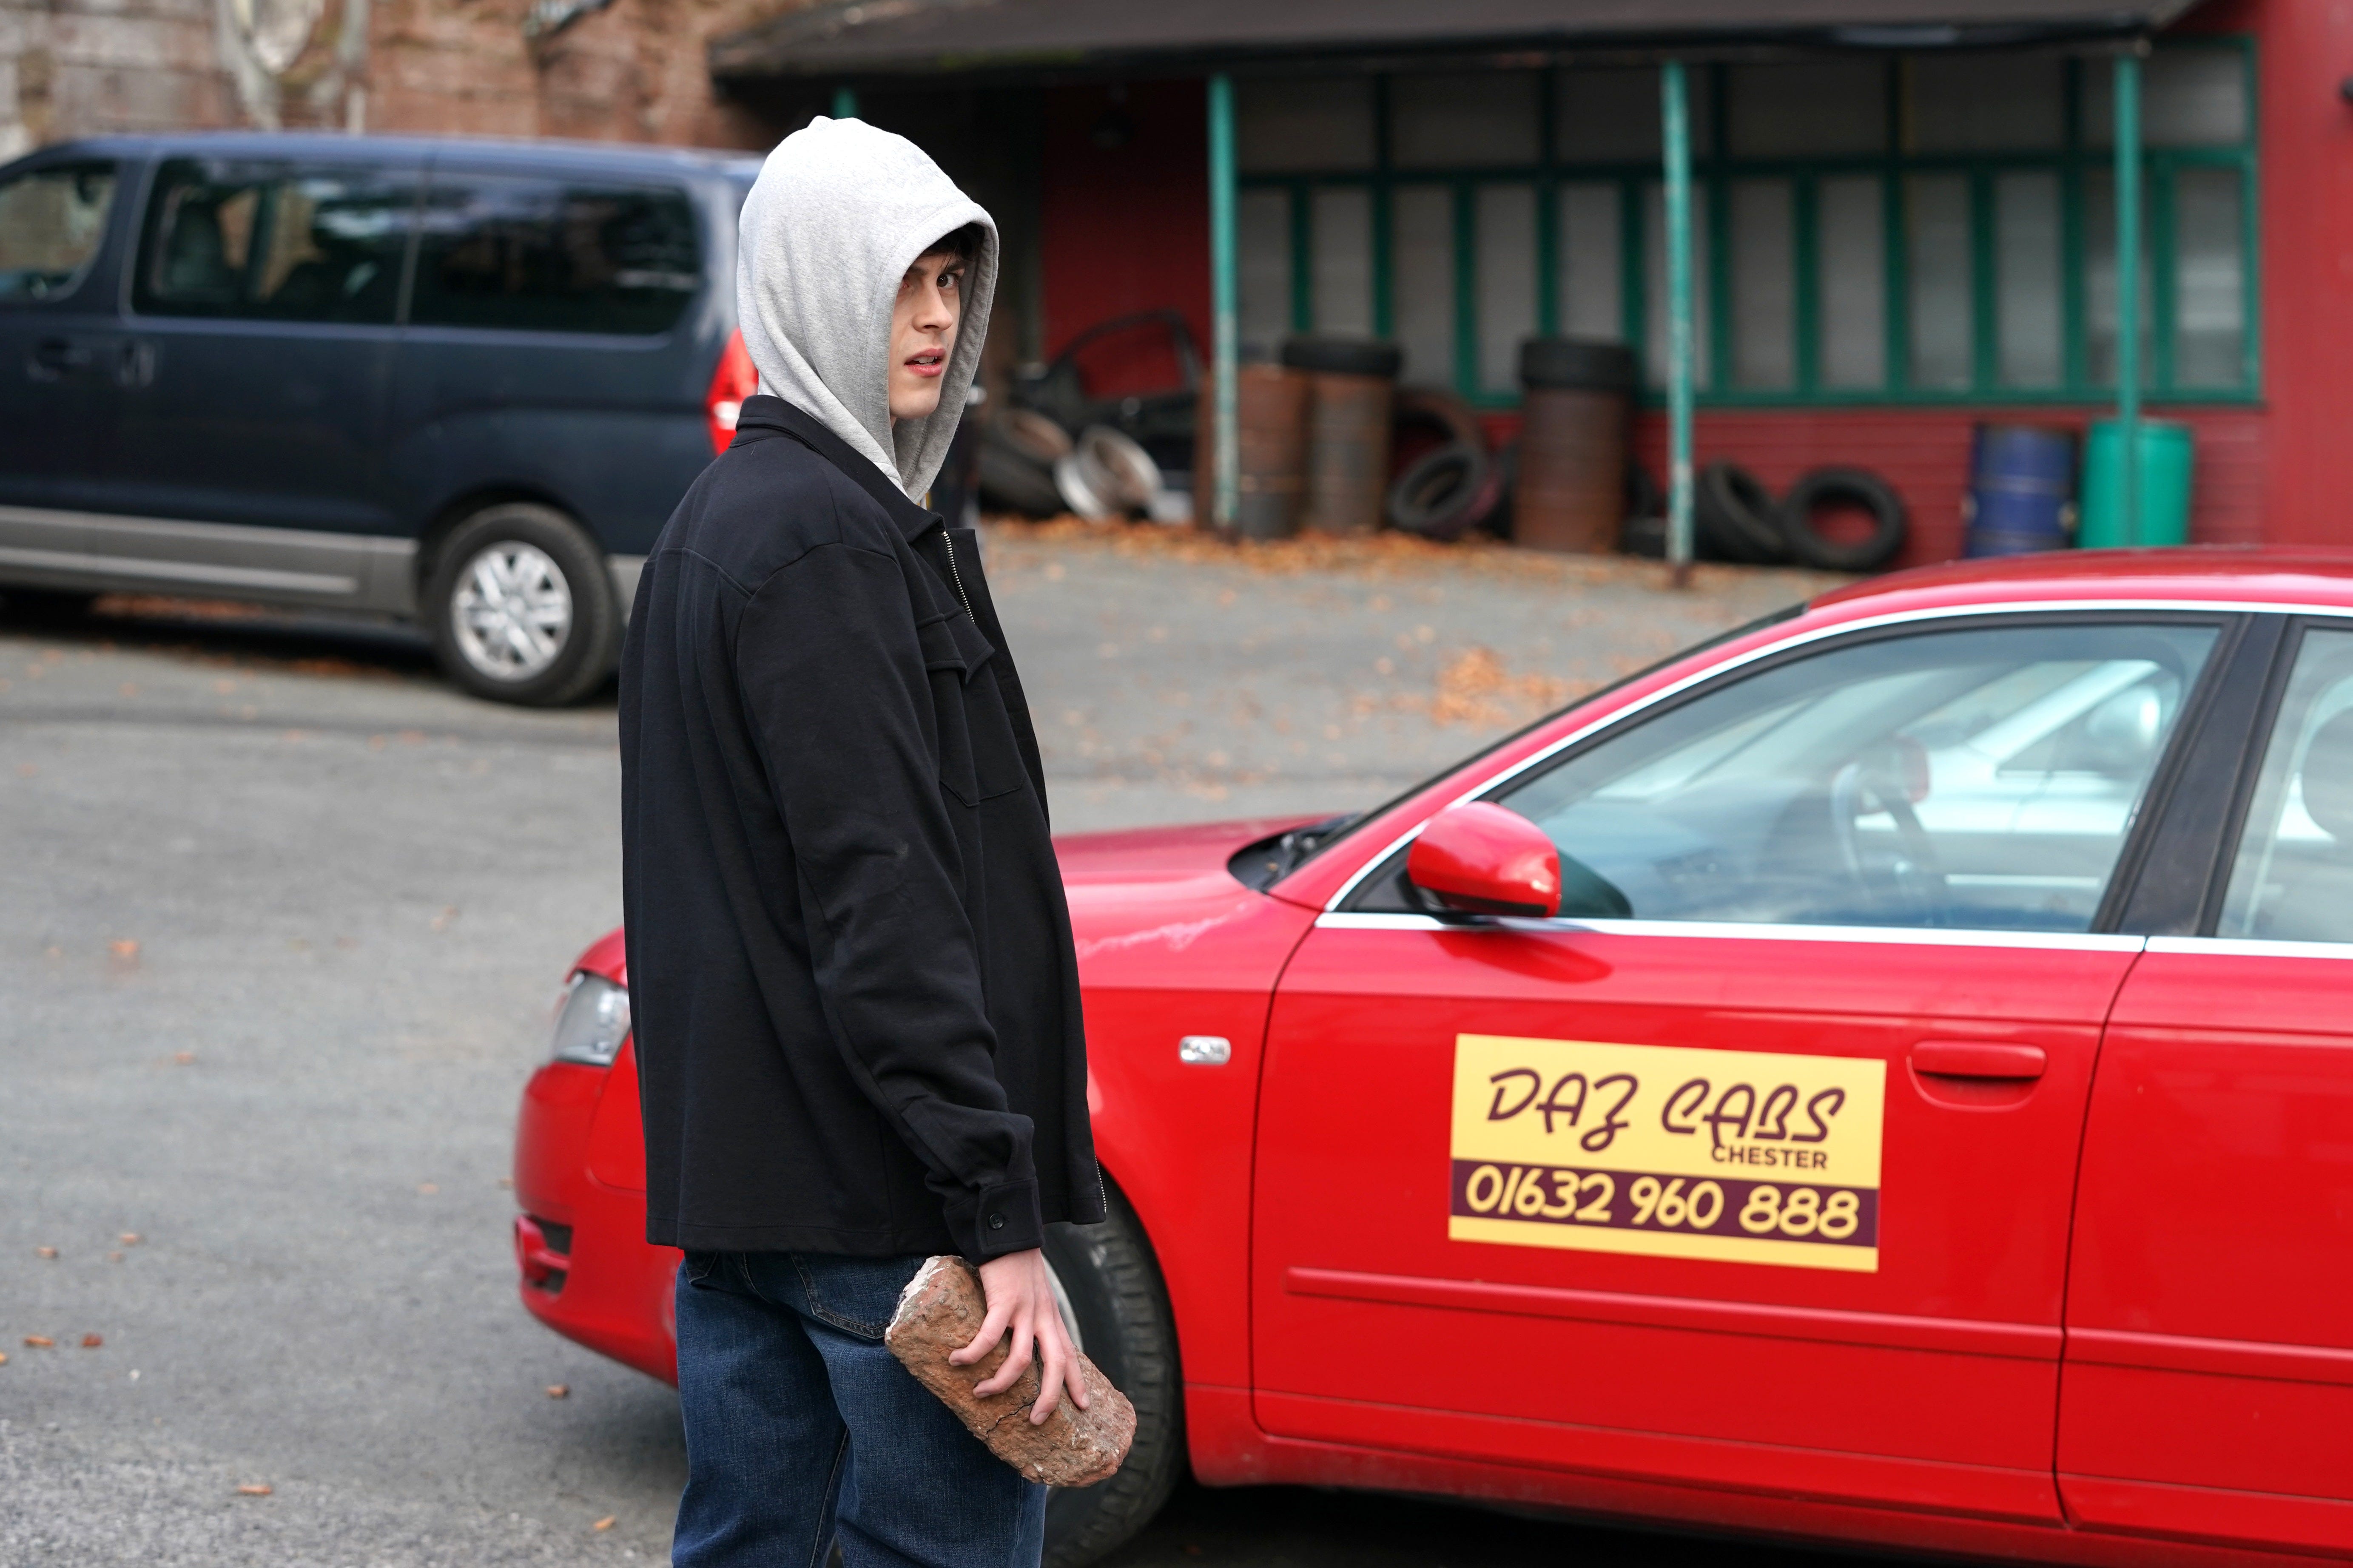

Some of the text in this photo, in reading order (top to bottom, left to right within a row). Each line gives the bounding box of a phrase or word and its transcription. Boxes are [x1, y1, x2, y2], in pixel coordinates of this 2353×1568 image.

[1487, 1068, 1845, 1153] DAZ CABS
[1711, 1145, 1828, 1170] CHESTER
[1466, 1165, 1859, 1238] 01632 960 888
